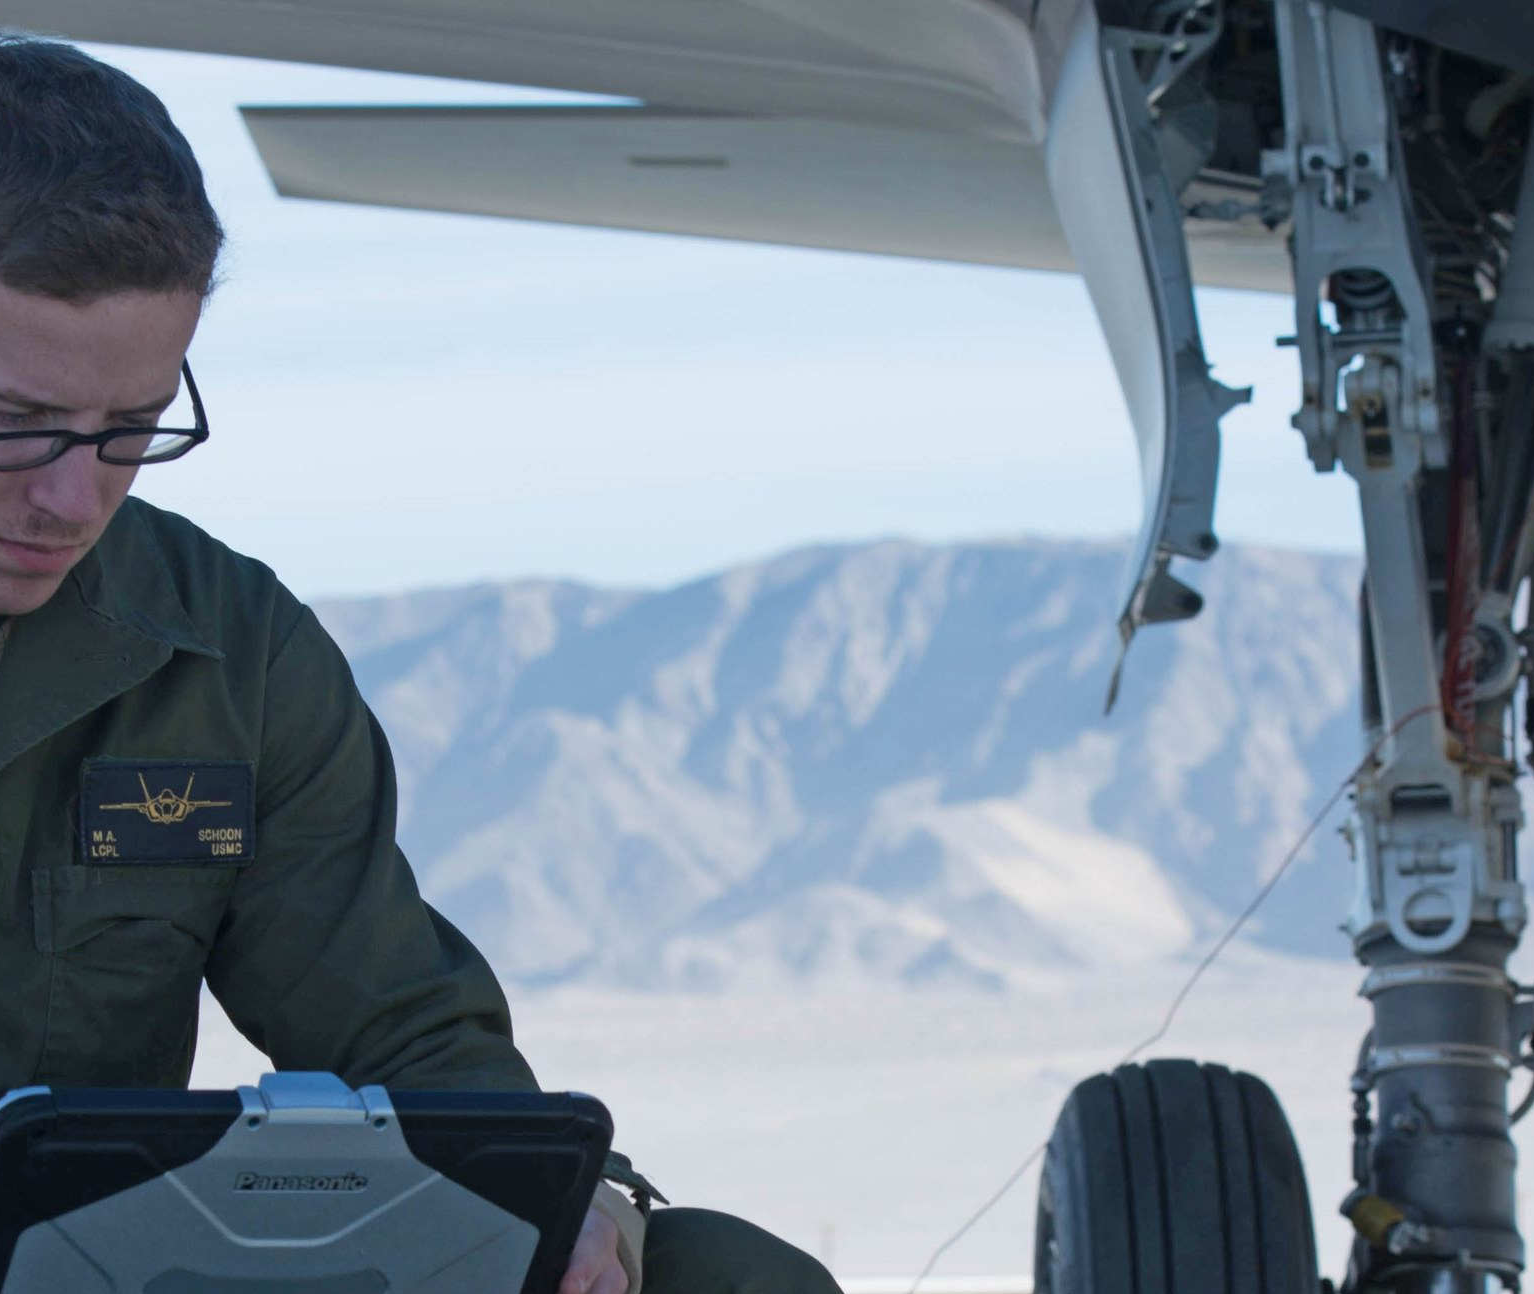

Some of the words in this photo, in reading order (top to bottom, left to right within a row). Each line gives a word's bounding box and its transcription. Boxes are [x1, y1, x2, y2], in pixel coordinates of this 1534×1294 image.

[197, 828, 243, 842] SCHOON
[91, 844, 120, 857] LCPL
[210, 842, 243, 856] USMC
[235, 1171, 367, 1192] Panasonic
